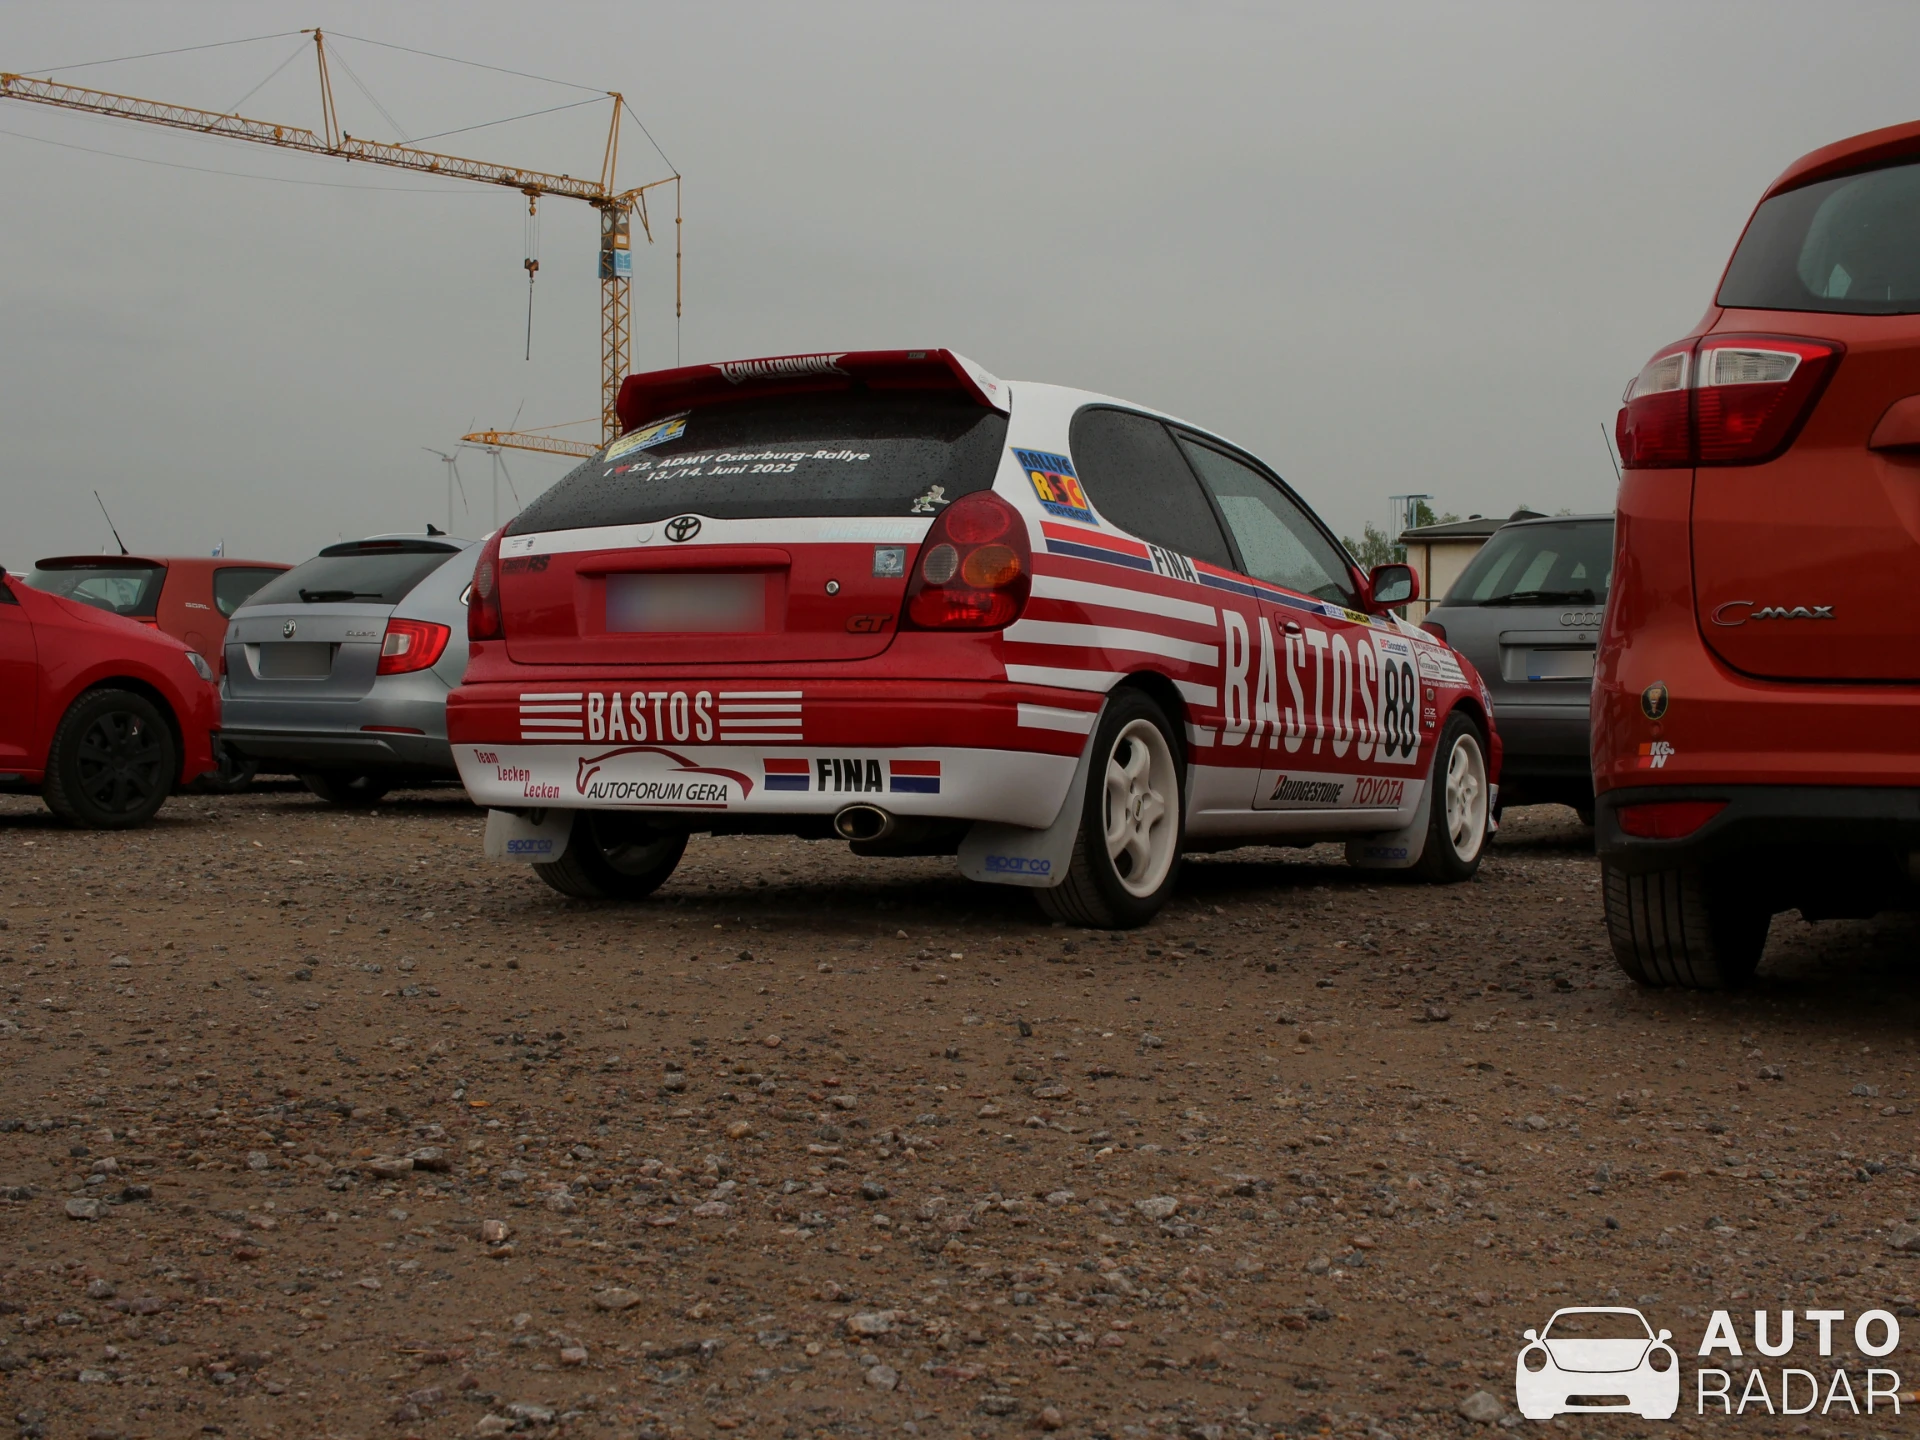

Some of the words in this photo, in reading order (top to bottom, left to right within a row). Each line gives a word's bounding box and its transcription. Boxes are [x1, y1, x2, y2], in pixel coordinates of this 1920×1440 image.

[628, 462, 653, 473] 52.
[657, 455, 714, 469] ADMV
[715, 450, 871, 463] Osterburg-Rallye
[646, 467, 702, 481] 13./14.
[707, 464, 748, 476] Juni
[750, 463, 798, 474] 2025
[1017, 451, 1074, 476] RALLYE
[1031, 471, 1086, 508] RSC
[1148, 544, 1197, 583] FINA
[846, 615, 894, 635] GT
[1222, 608, 1378, 762] BASTOS
[587, 690, 713, 742] BASTOS
[1384, 657, 1416, 759] 88
[473, 749, 499, 763] Team
[497, 765, 530, 782] Lecken
[816, 758, 883, 792] FINA
[524, 782, 560, 799] Lecken
[587, 782, 684, 800] AUTOFORUM
[686, 783, 728, 801] GERA
[1352, 777, 1404, 806] TOYOTA
[507, 839, 552, 853] sparco
[984, 855, 1051, 875] sparco
